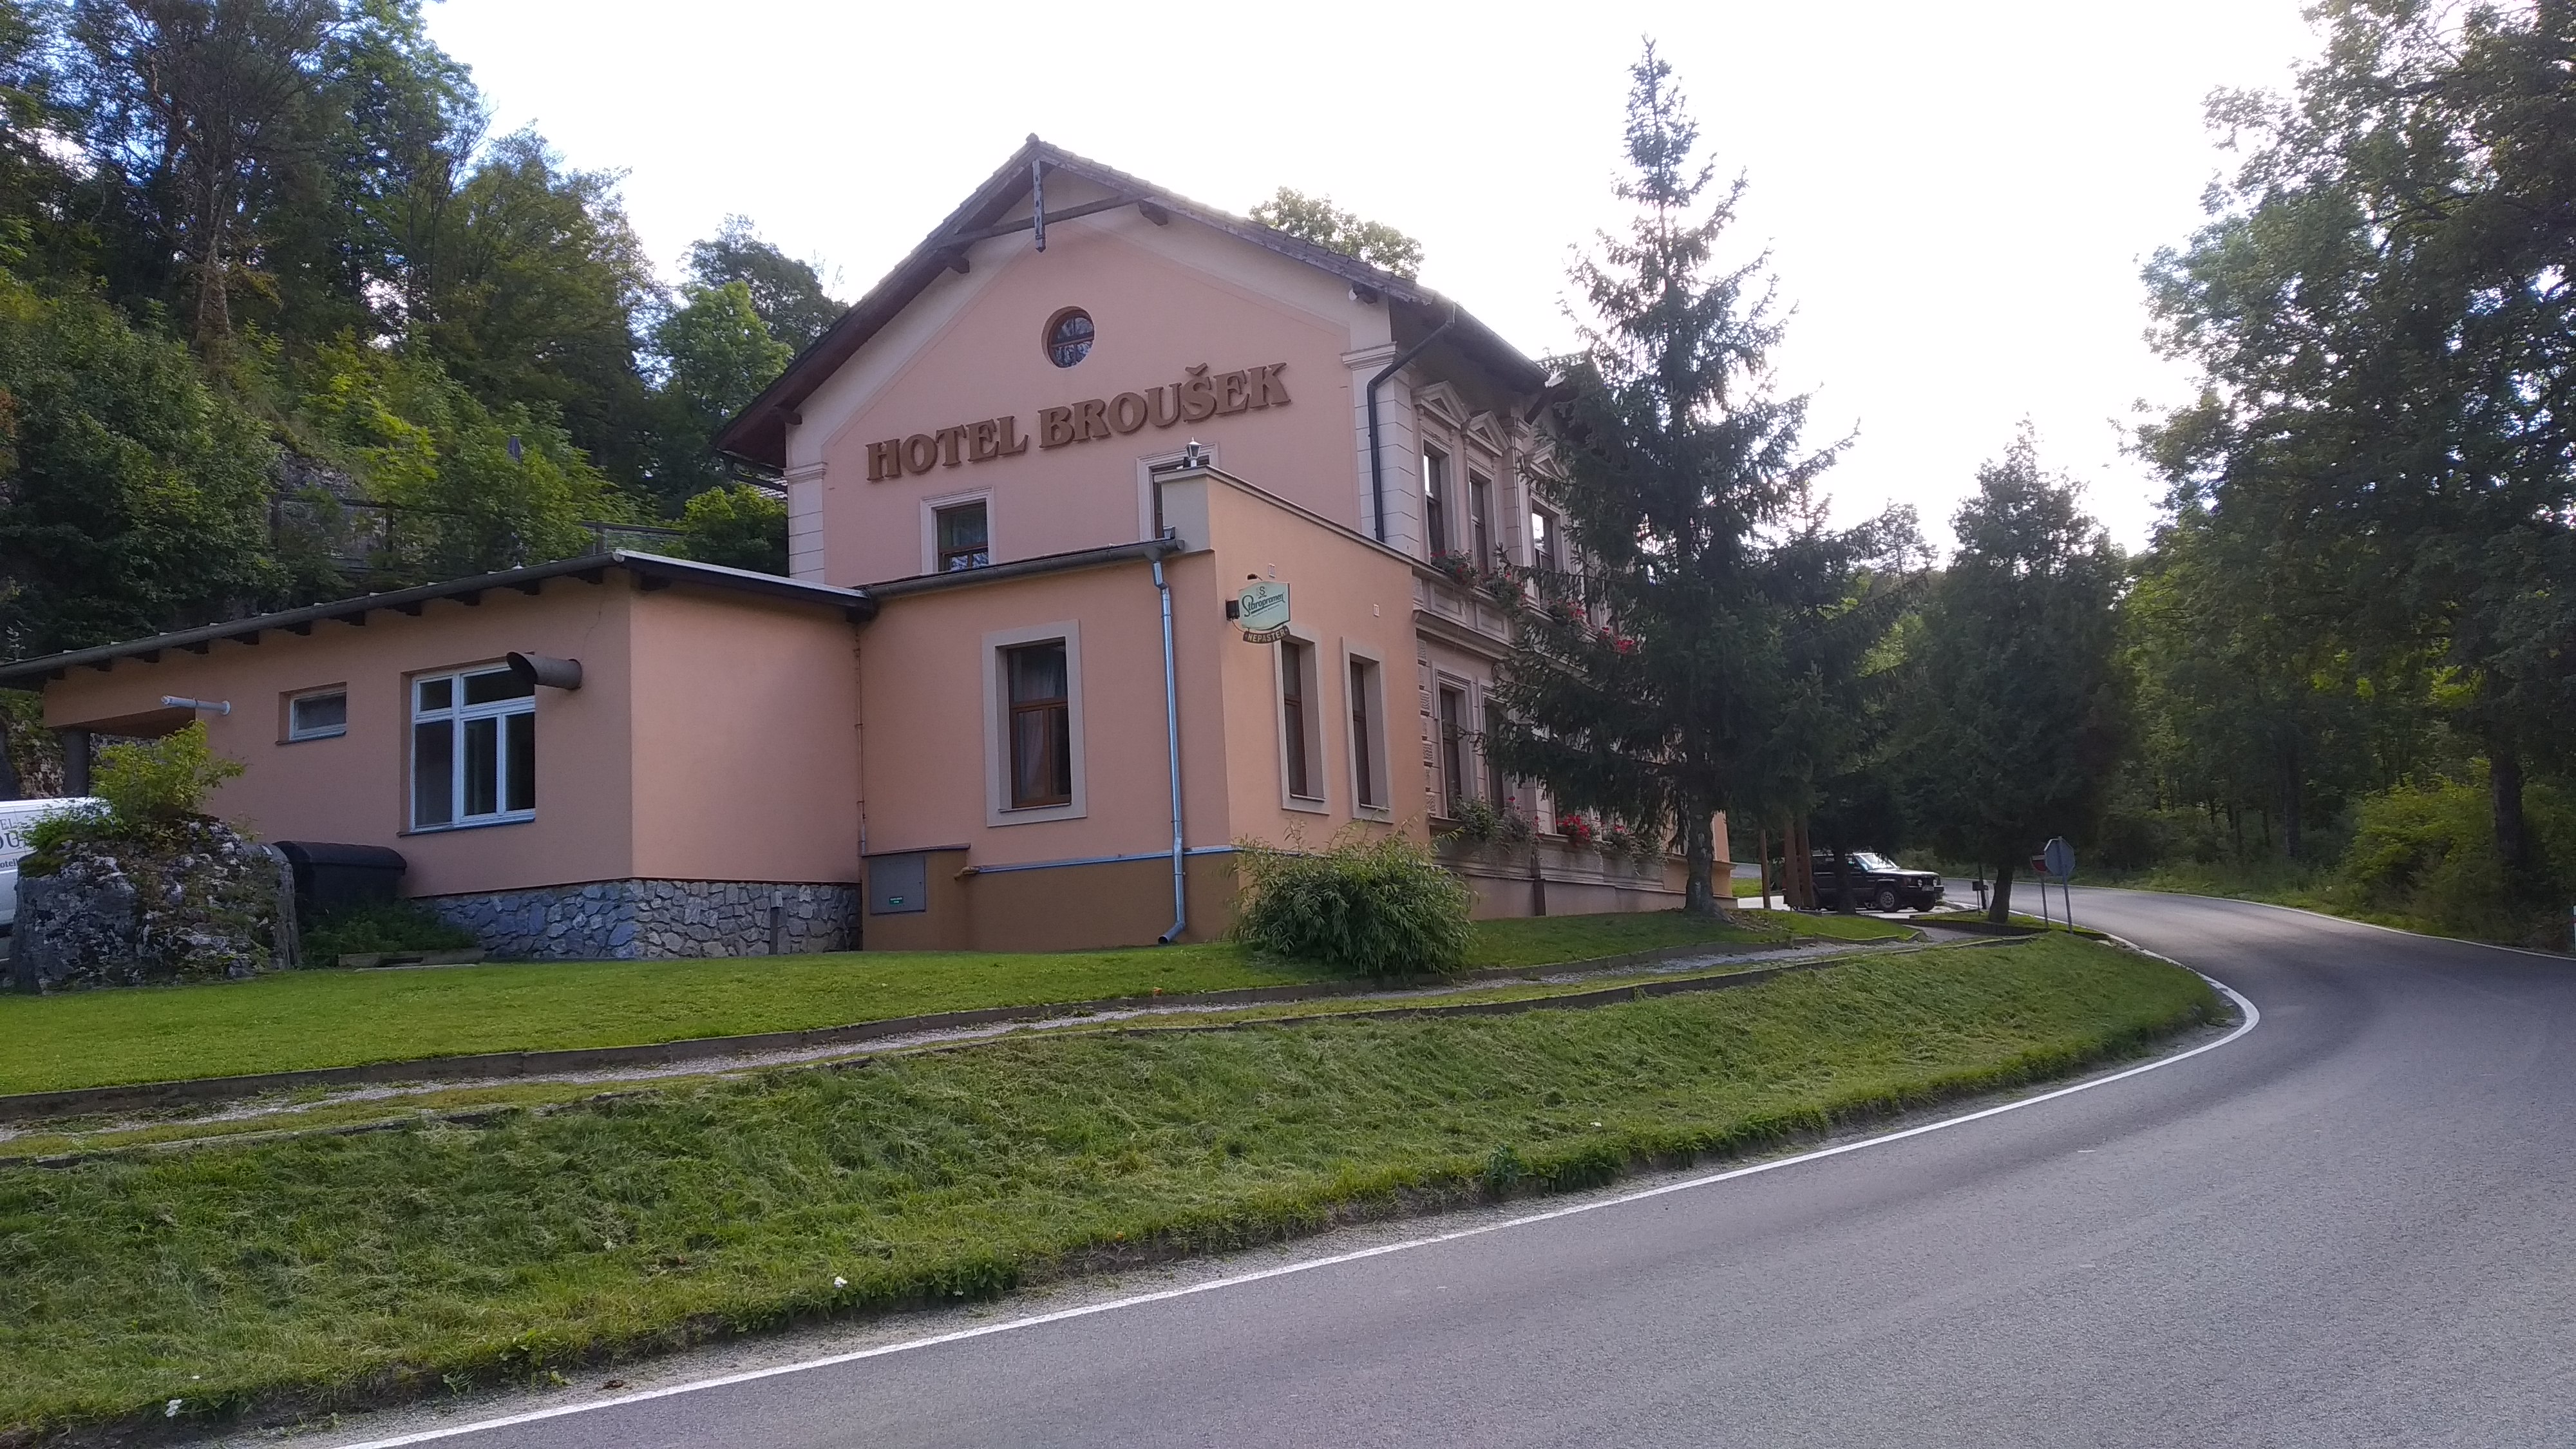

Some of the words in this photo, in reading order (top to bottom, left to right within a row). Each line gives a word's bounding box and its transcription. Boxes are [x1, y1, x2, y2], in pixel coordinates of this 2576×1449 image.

[866, 415, 1029, 482] HOTEL
[1037, 363, 1291, 449] BROUŠEK
[1242, 594, 1285, 617] Staropramen
[1247, 629, 1286, 643] NEPASTER
